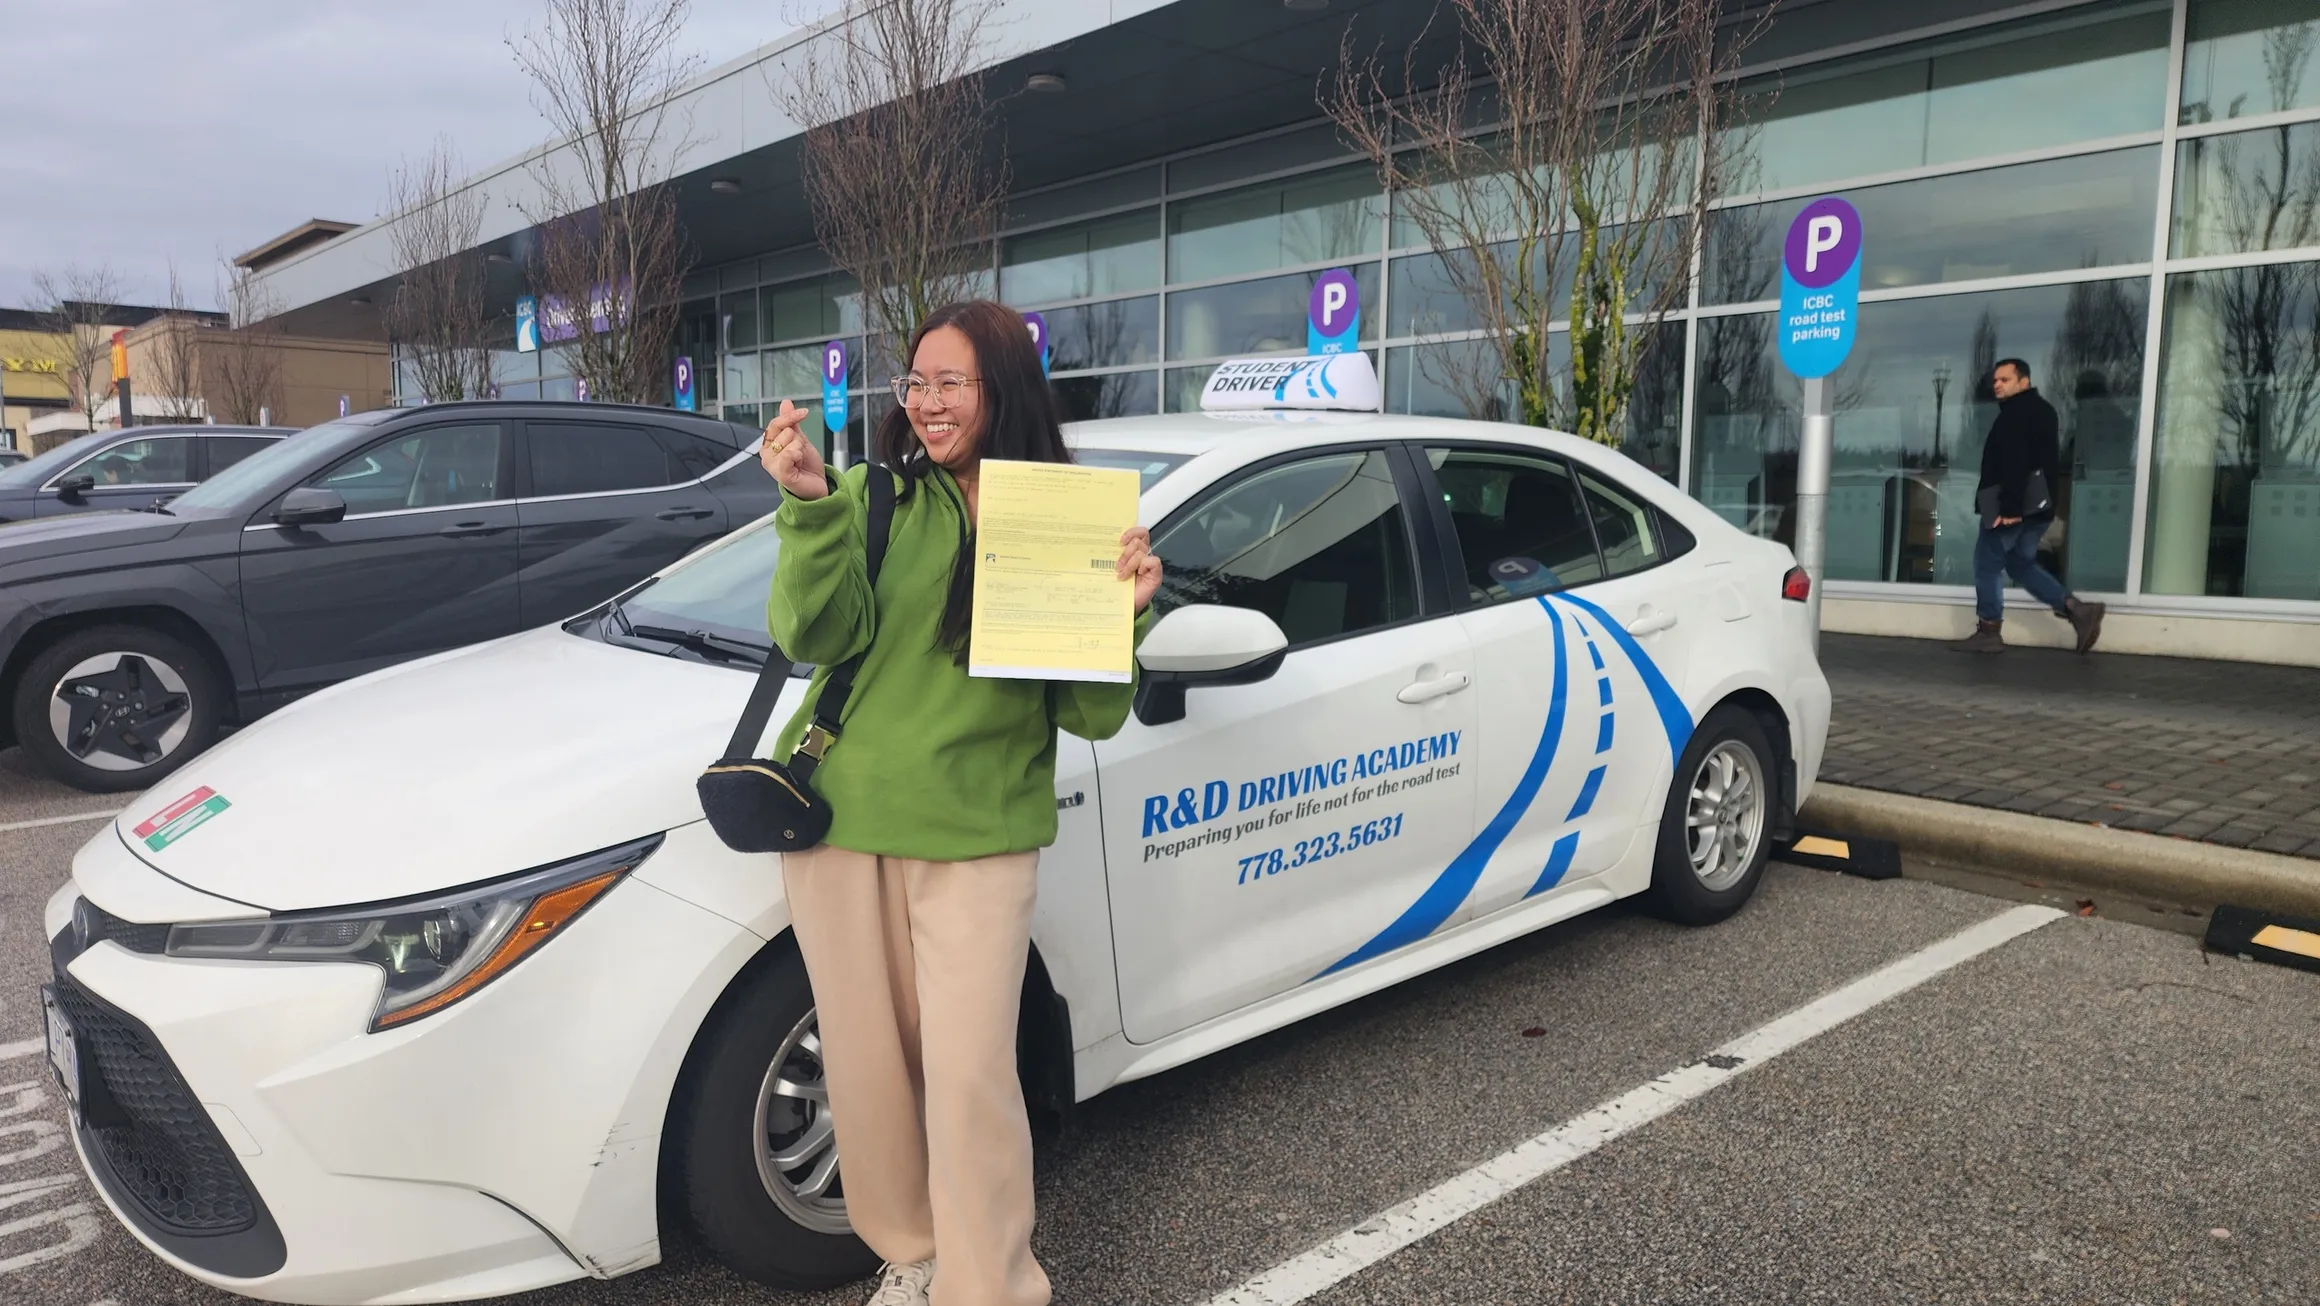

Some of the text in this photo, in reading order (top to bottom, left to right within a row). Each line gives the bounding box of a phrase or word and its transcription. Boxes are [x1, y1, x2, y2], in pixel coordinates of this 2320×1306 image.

[1805, 214, 1843, 273] P
[1322, 281, 1347, 326] P
[1803, 295, 1834, 310] ICBC
[1789, 309, 1846, 327] road test
[1792, 325, 1841, 344] parking
[678, 364, 688, 390] P
[828, 349, 841, 379] P
[1217, 360, 1315, 375] STUDENT
[1212, 375, 1292, 392] DRIVER
[1142, 730, 1462, 838] R&D DRIVING ACADEMY
[1143, 762, 1461, 863] Preparing you for life not for the road test
[1238, 812, 1403, 886] 778.323.5631
